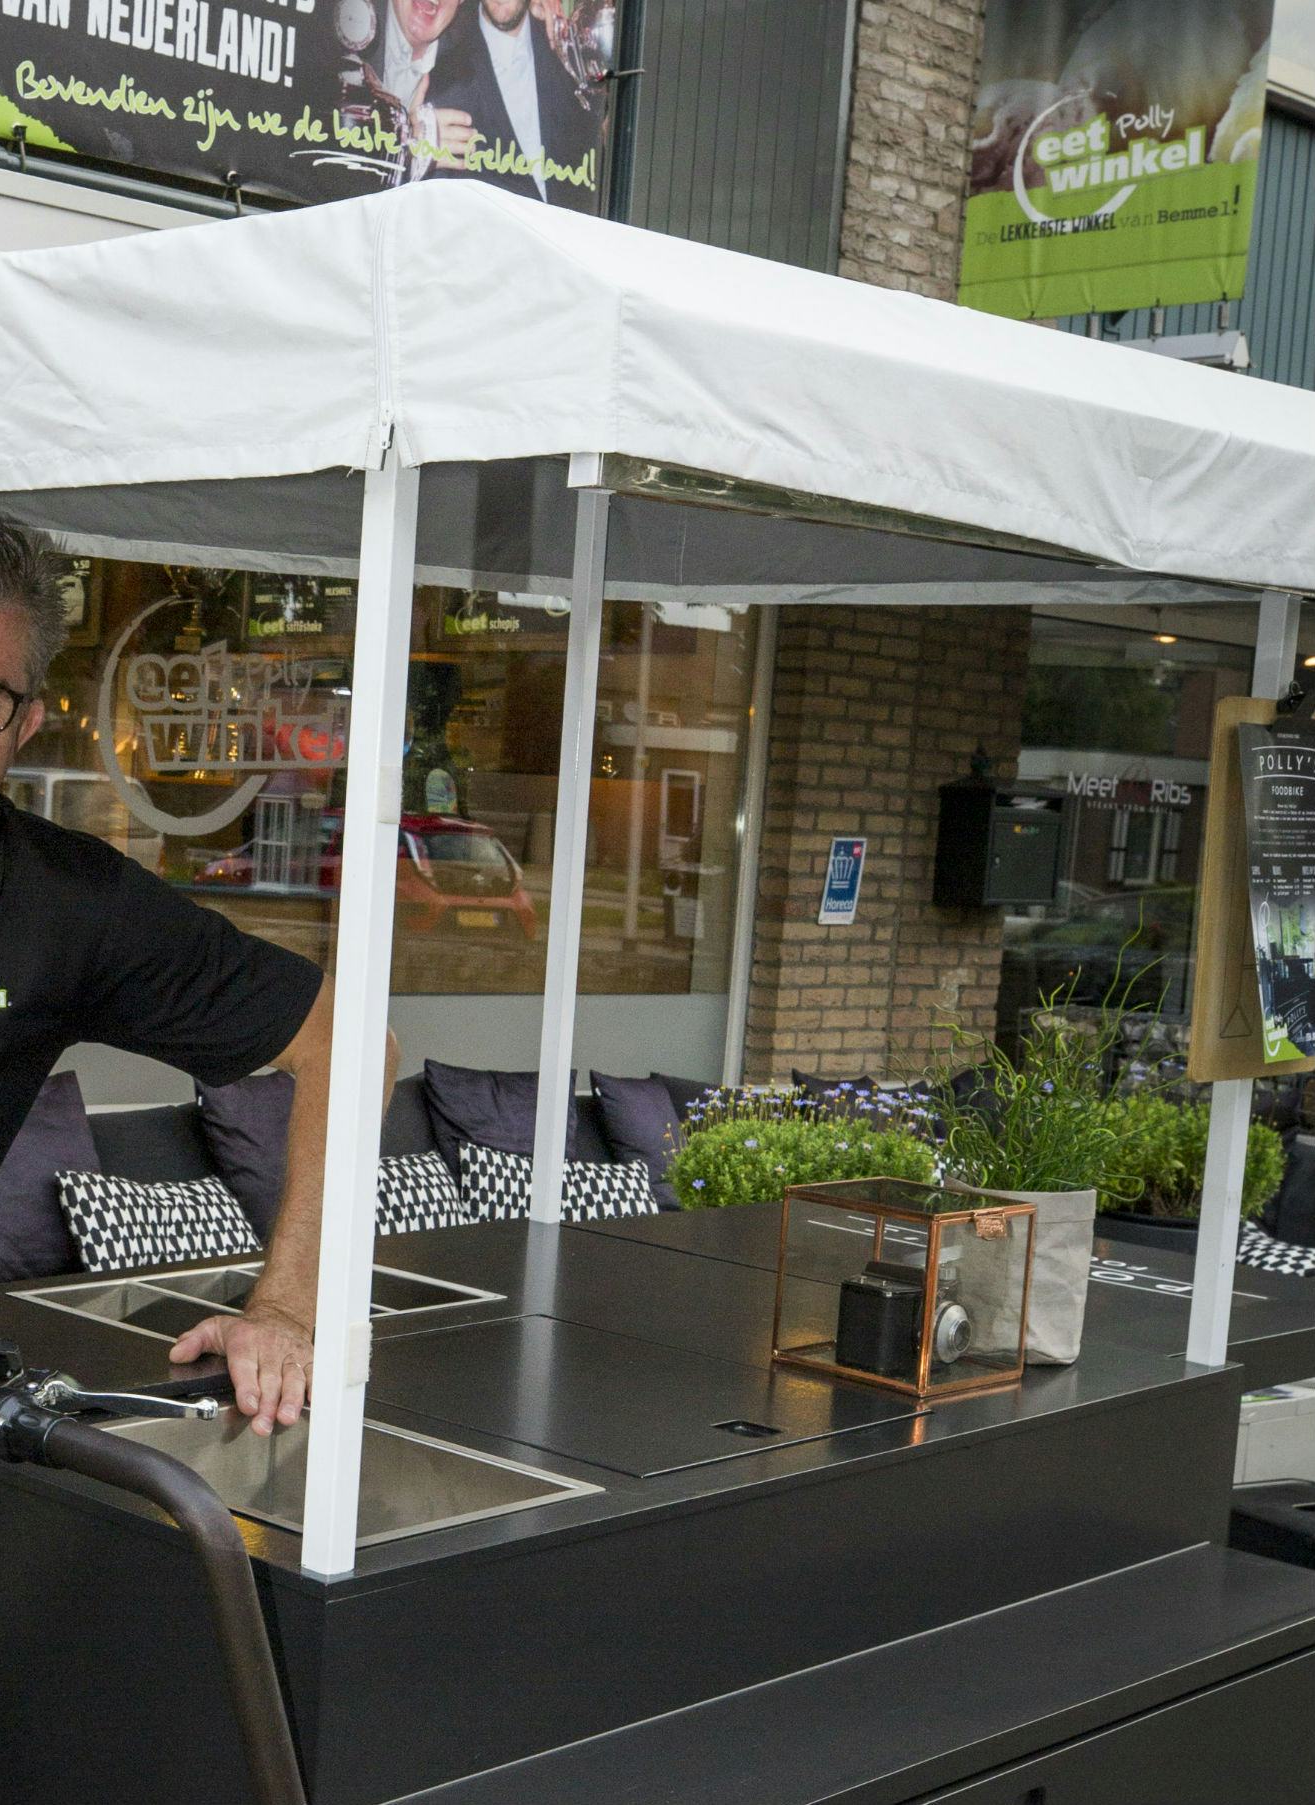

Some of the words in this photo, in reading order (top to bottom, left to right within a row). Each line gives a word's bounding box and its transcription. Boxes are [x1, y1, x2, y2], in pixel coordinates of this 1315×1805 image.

[87, 0, 296, 88] NEDERLAND!
[16, 60, 176, 119] Bovendien
[183, 89, 241, 151] zijn
[248, 111, 287, 136] we
[293, 105, 328, 142] de
[333, 108, 402, 153] beste
[410, 140, 460, 163] van
[464, 134, 596, 191] Gelderland!
[1037, 119, 1106, 161] eet
[1116, 103, 1175, 138] Polly
[1049, 129, 1202, 193] winkel
[1071, 212, 1117, 235] WINKEL
[127, 639, 228, 712] eet
[1259, 753, 1315, 772] POLLY'
[1067, 771, 1119, 798] Meet
[1150, 779, 1192, 805] Ribs
[1271, 785, 1304, 796] FOODBIKE
[825, 897, 854, 911] Horeca
